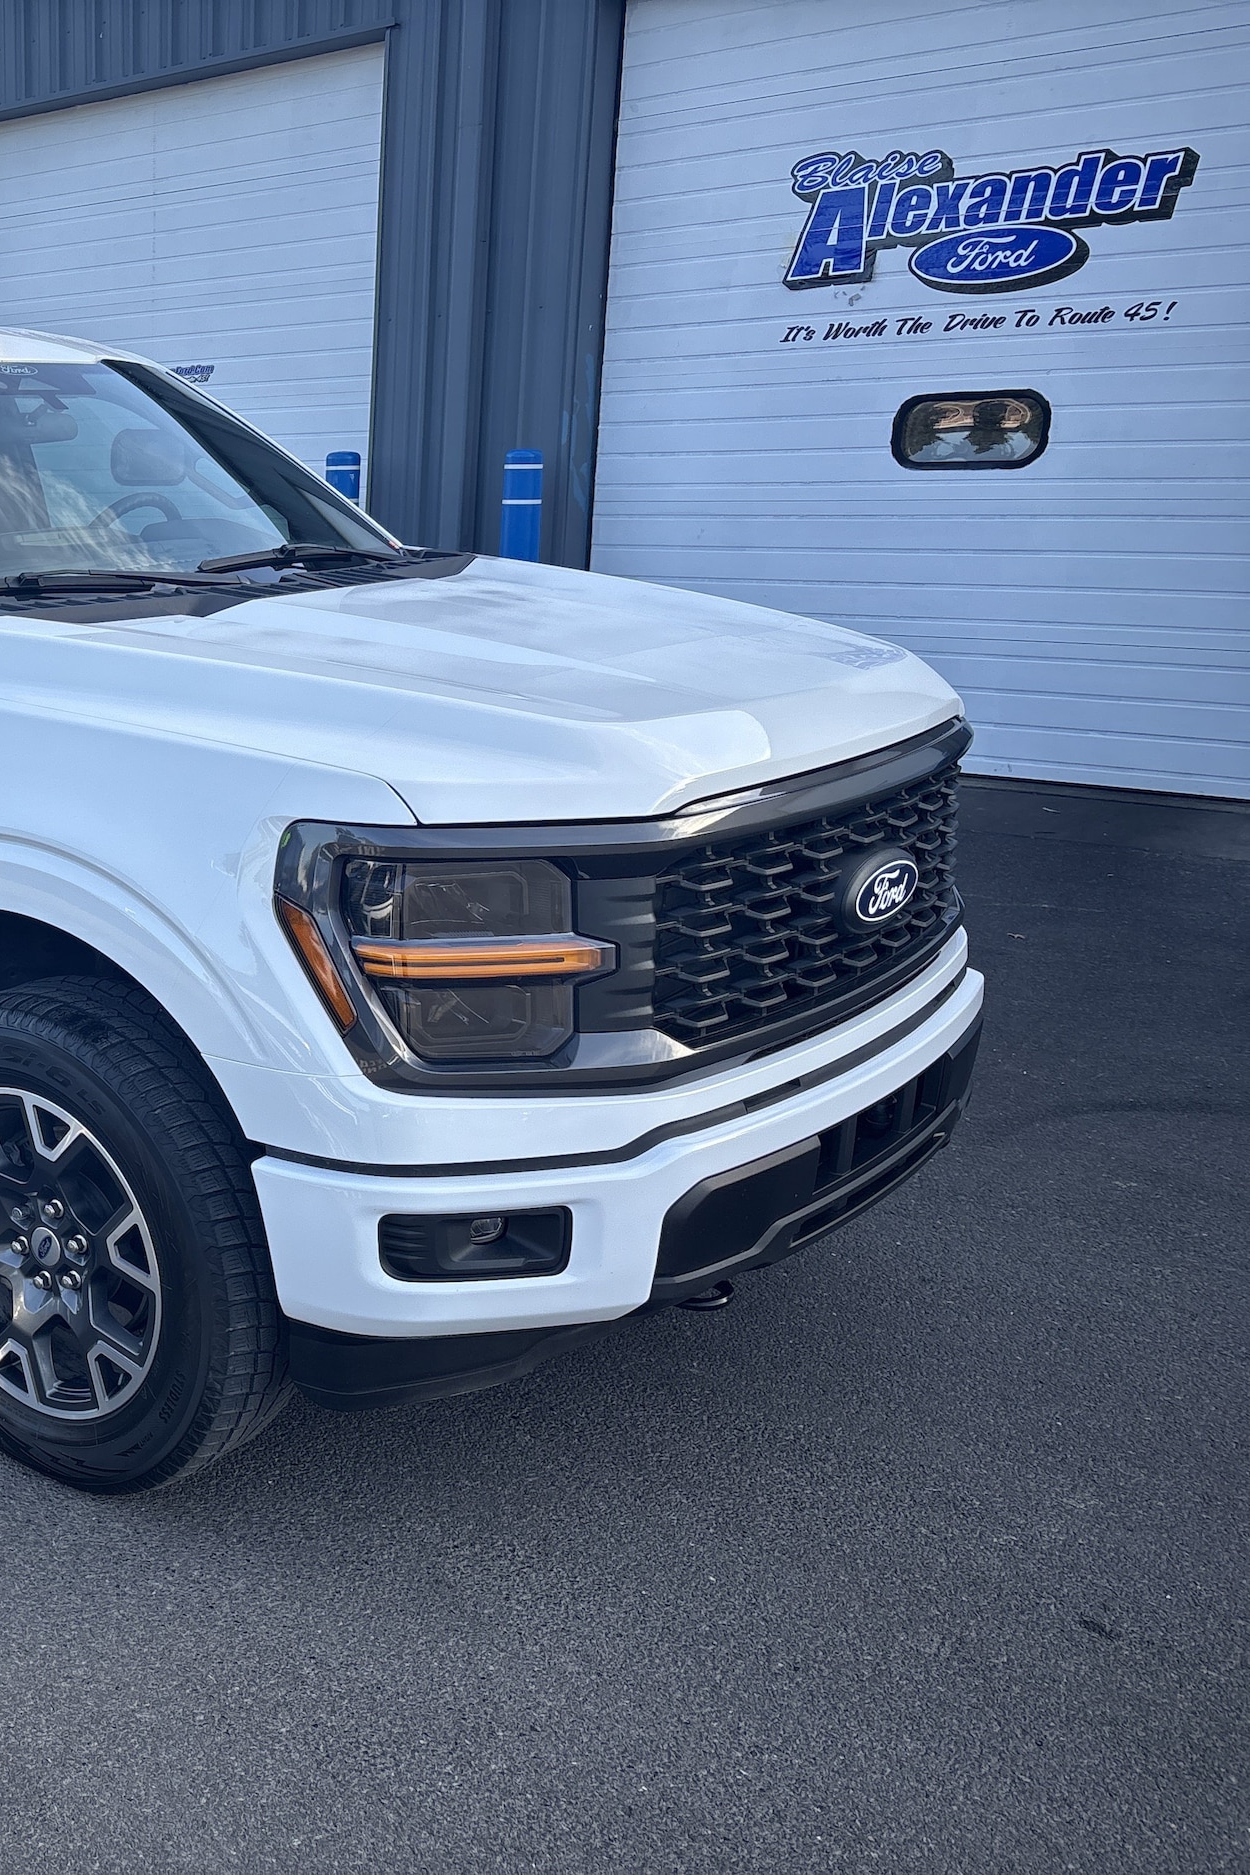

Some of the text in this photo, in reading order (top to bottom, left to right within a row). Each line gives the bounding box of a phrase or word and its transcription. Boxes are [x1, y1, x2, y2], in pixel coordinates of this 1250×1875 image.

[793, 150, 945, 194] Blaise
[786, 150, 1188, 282] Alexander
[946, 235, 1040, 274] Ford
[779, 325, 816, 343] It's
[822, 318, 888, 341] Worth
[895, 316, 933, 336] The
[943, 313, 1007, 332] Drive
[1014, 308, 1040, 328] To
[1048, 306, 1116, 326] Route
[0, 363, 31, 374] Ford
[868, 869, 909, 915] Ford
